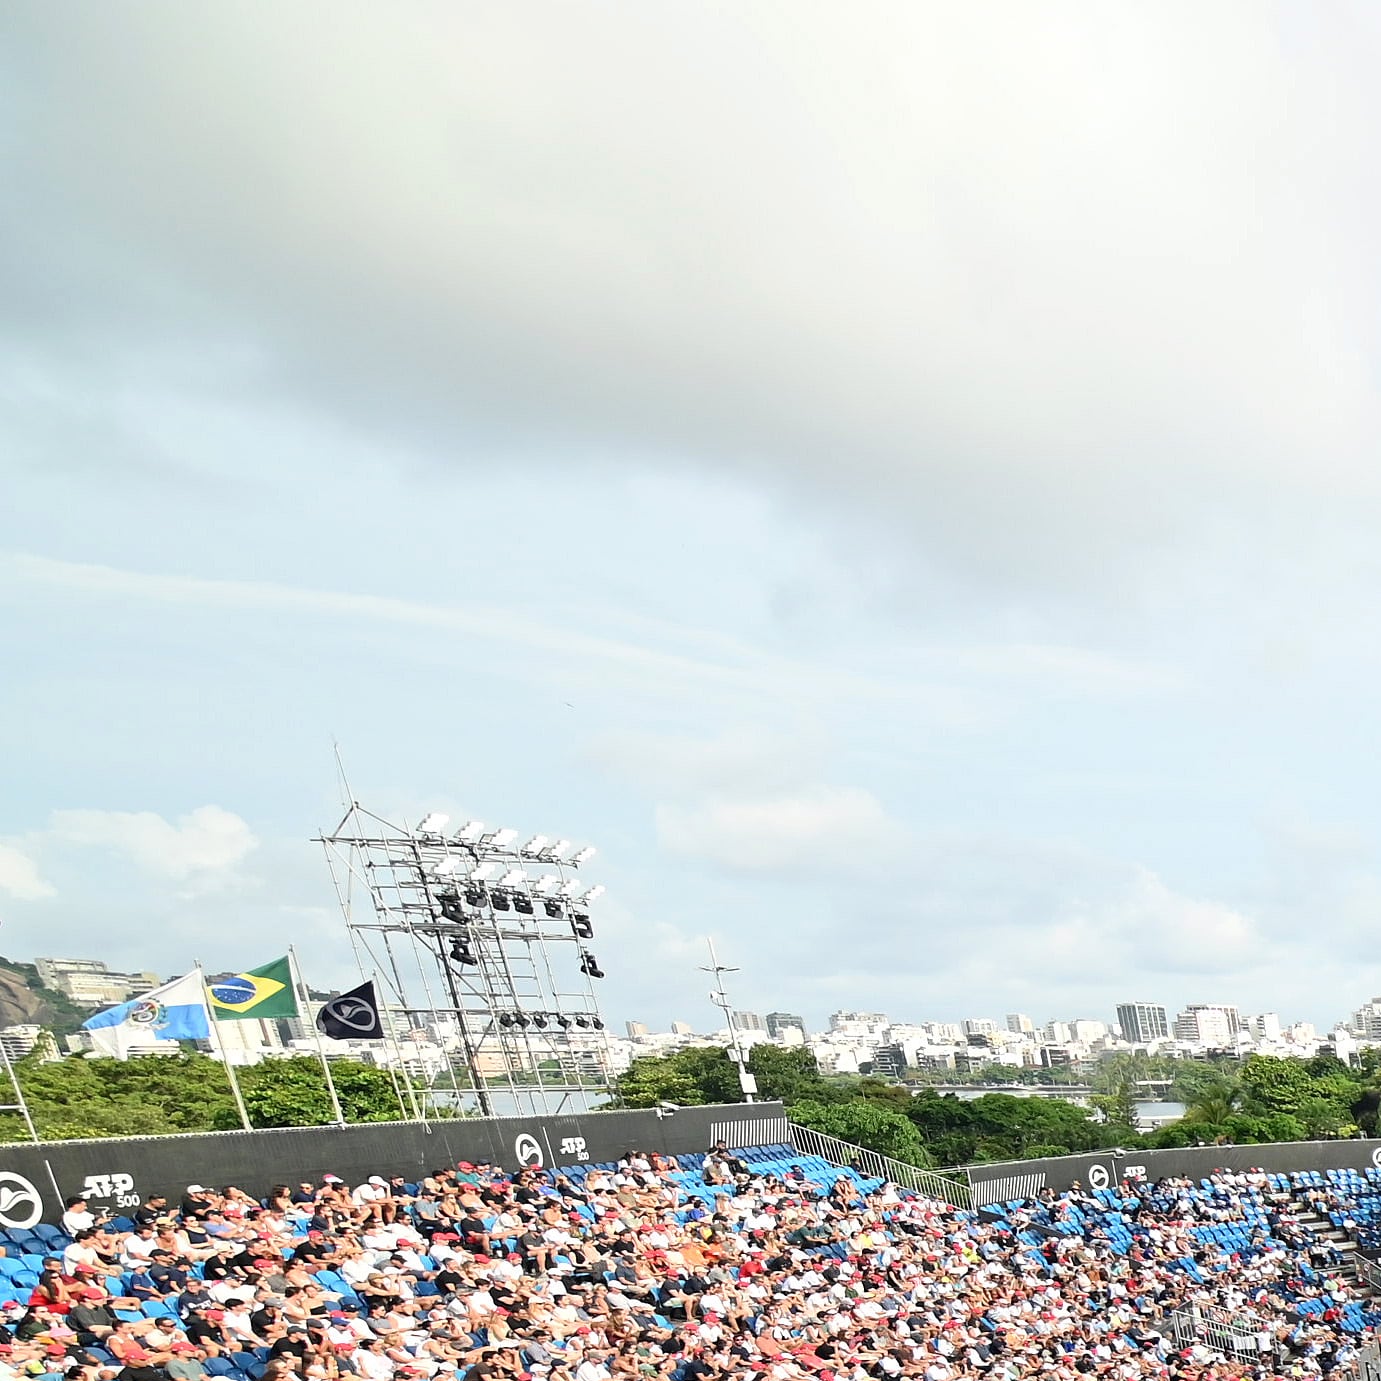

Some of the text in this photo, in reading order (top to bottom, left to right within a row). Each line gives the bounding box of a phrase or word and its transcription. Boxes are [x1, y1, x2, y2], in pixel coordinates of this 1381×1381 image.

[560, 1136, 586, 1155] ATP
[577, 1151, 590, 1161] 500
[78, 1173, 134, 1200] ATP
[116, 1194, 141, 1208] 500
